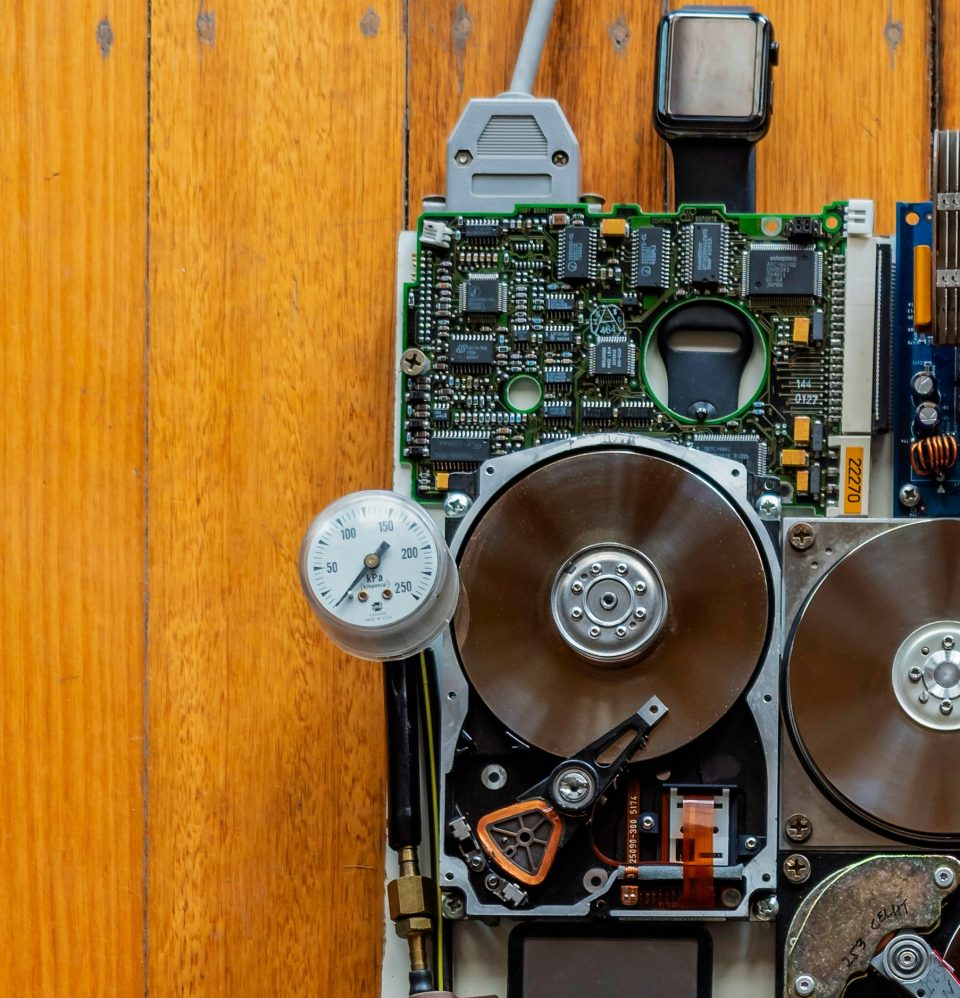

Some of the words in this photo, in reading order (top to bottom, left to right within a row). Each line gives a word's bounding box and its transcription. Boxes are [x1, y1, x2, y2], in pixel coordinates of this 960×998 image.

[848, 457, 862, 503] 22270
[379, 521, 393, 532] 150
[341, 528, 356, 540] 100
[402, 547, 418, 559] 200
[327, 562, 337, 572] 50
[366, 574, 383, 583] kPa
[395, 581, 412, 593] 250
[630, 819, 638, 864] 25090-300
